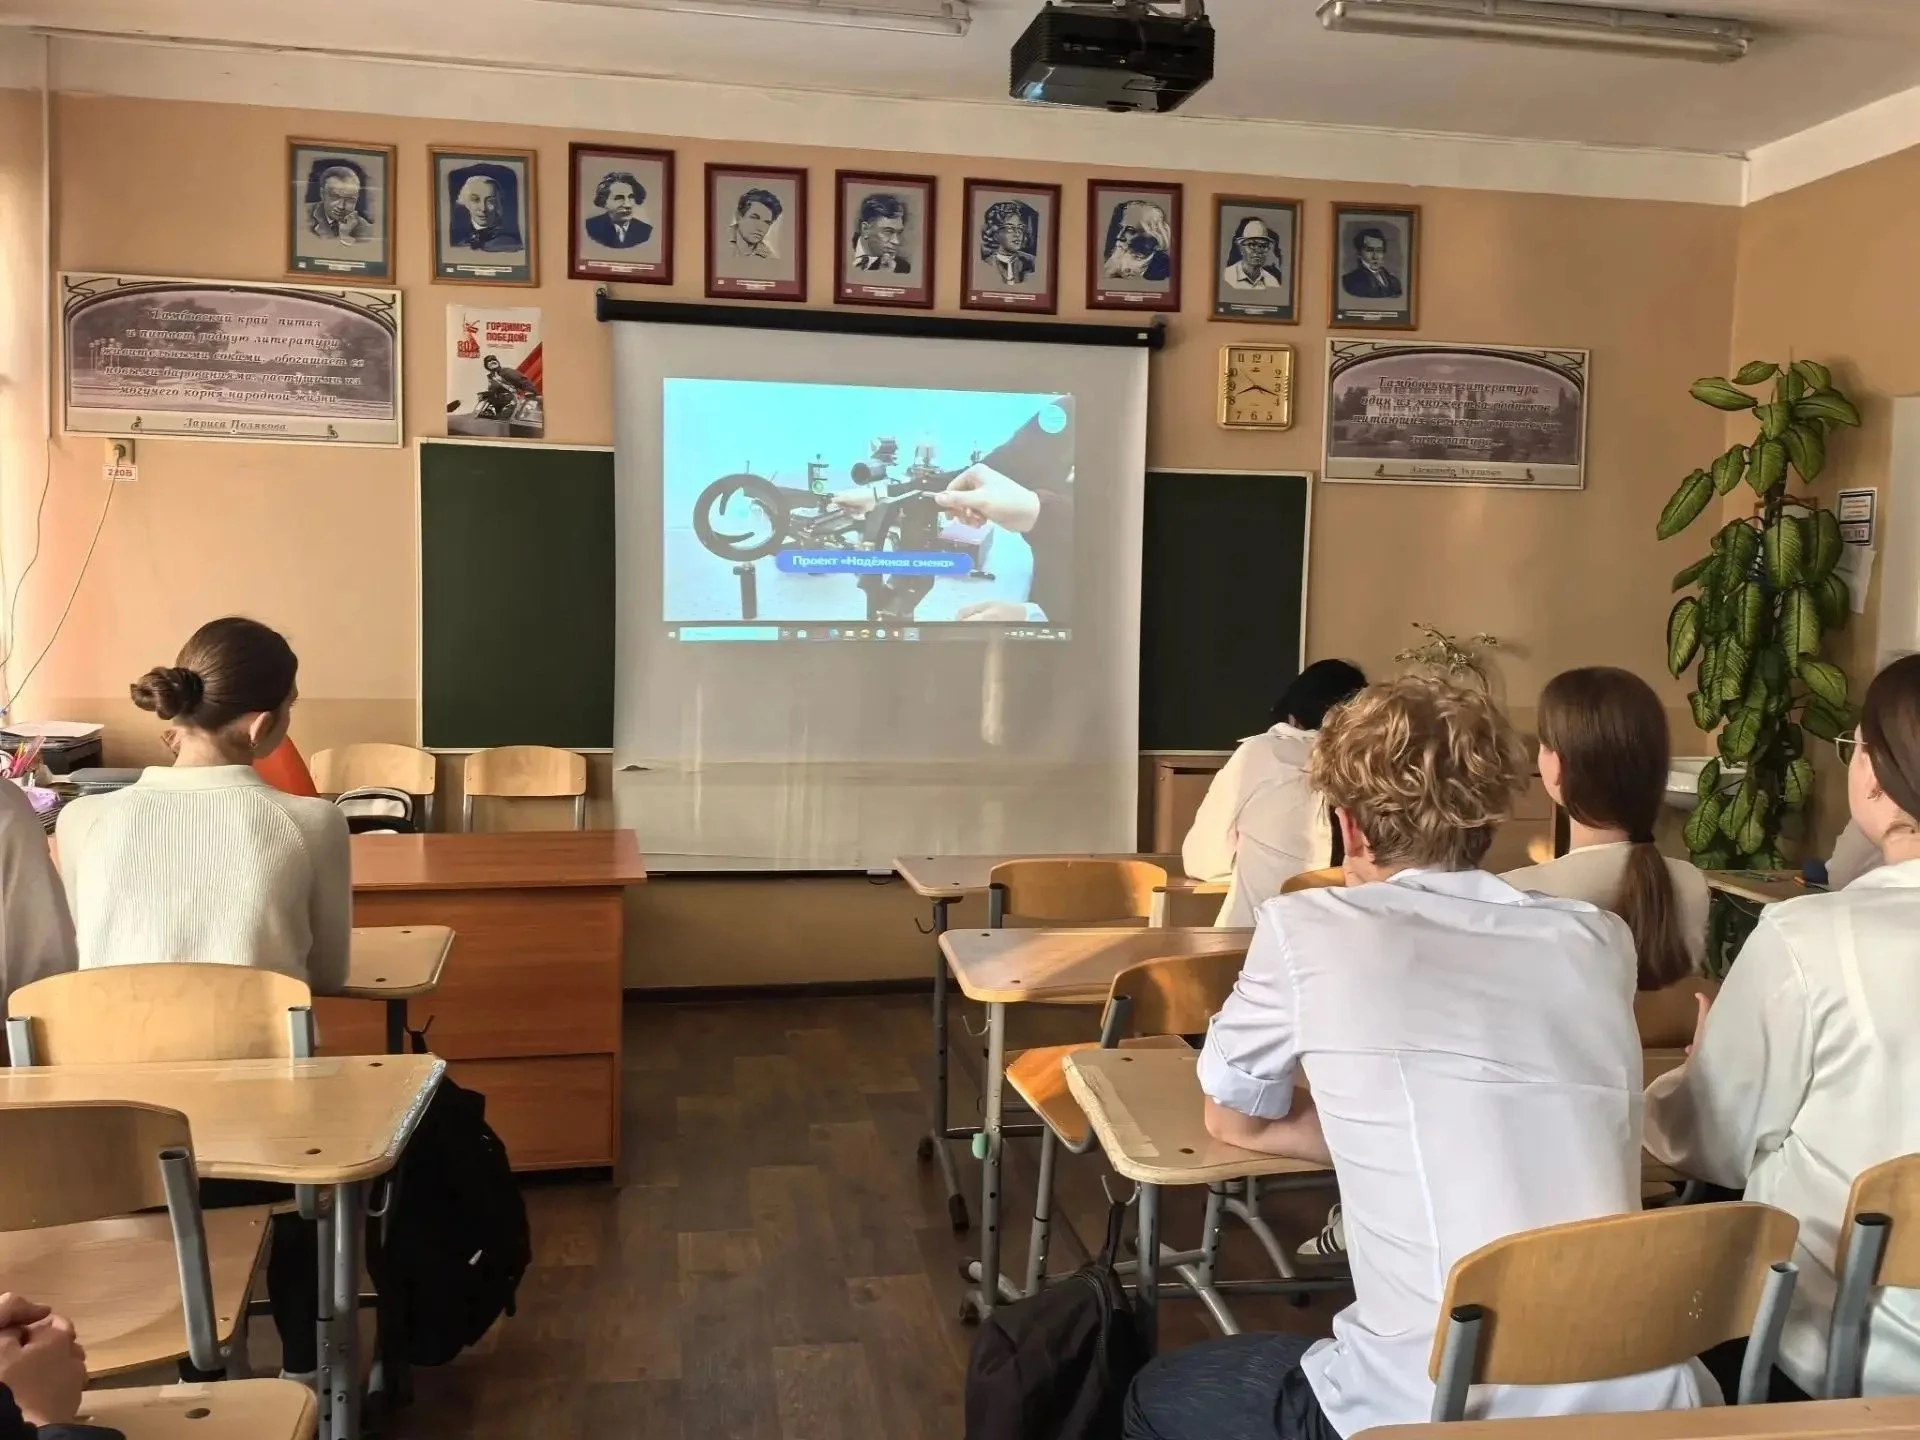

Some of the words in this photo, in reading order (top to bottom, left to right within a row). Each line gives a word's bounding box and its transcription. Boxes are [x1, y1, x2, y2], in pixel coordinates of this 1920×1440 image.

[237, 314, 268, 326] край
[278, 317, 321, 328] питал
[486, 322, 531, 332] ГОРДИМСЯ
[199, 328, 249, 345] родную
[254, 336, 339, 350] литературу
[275, 354, 347, 367] обогащает
[1252, 353, 1261, 364] 12
[105, 366, 158, 377] новыми
[262, 373, 341, 386] растущими
[121, 387, 179, 398] могучего
[184, 389, 223, 399] корня
[228, 390, 289, 403] народной
[295, 393, 337, 403] жизни
[1457, 382, 1539, 396] литература
[1361, 395, 1391, 408] один
[1397, 399, 1411, 407] из
[1236, 411, 1242, 420] 7
[1250, 411, 1258, 421] 6
[183, 417, 227, 430] Лариса
[231, 419, 288, 432] Полякова
[793, 555, 838, 568] Проект
[913, 560, 956, 568] смена»
